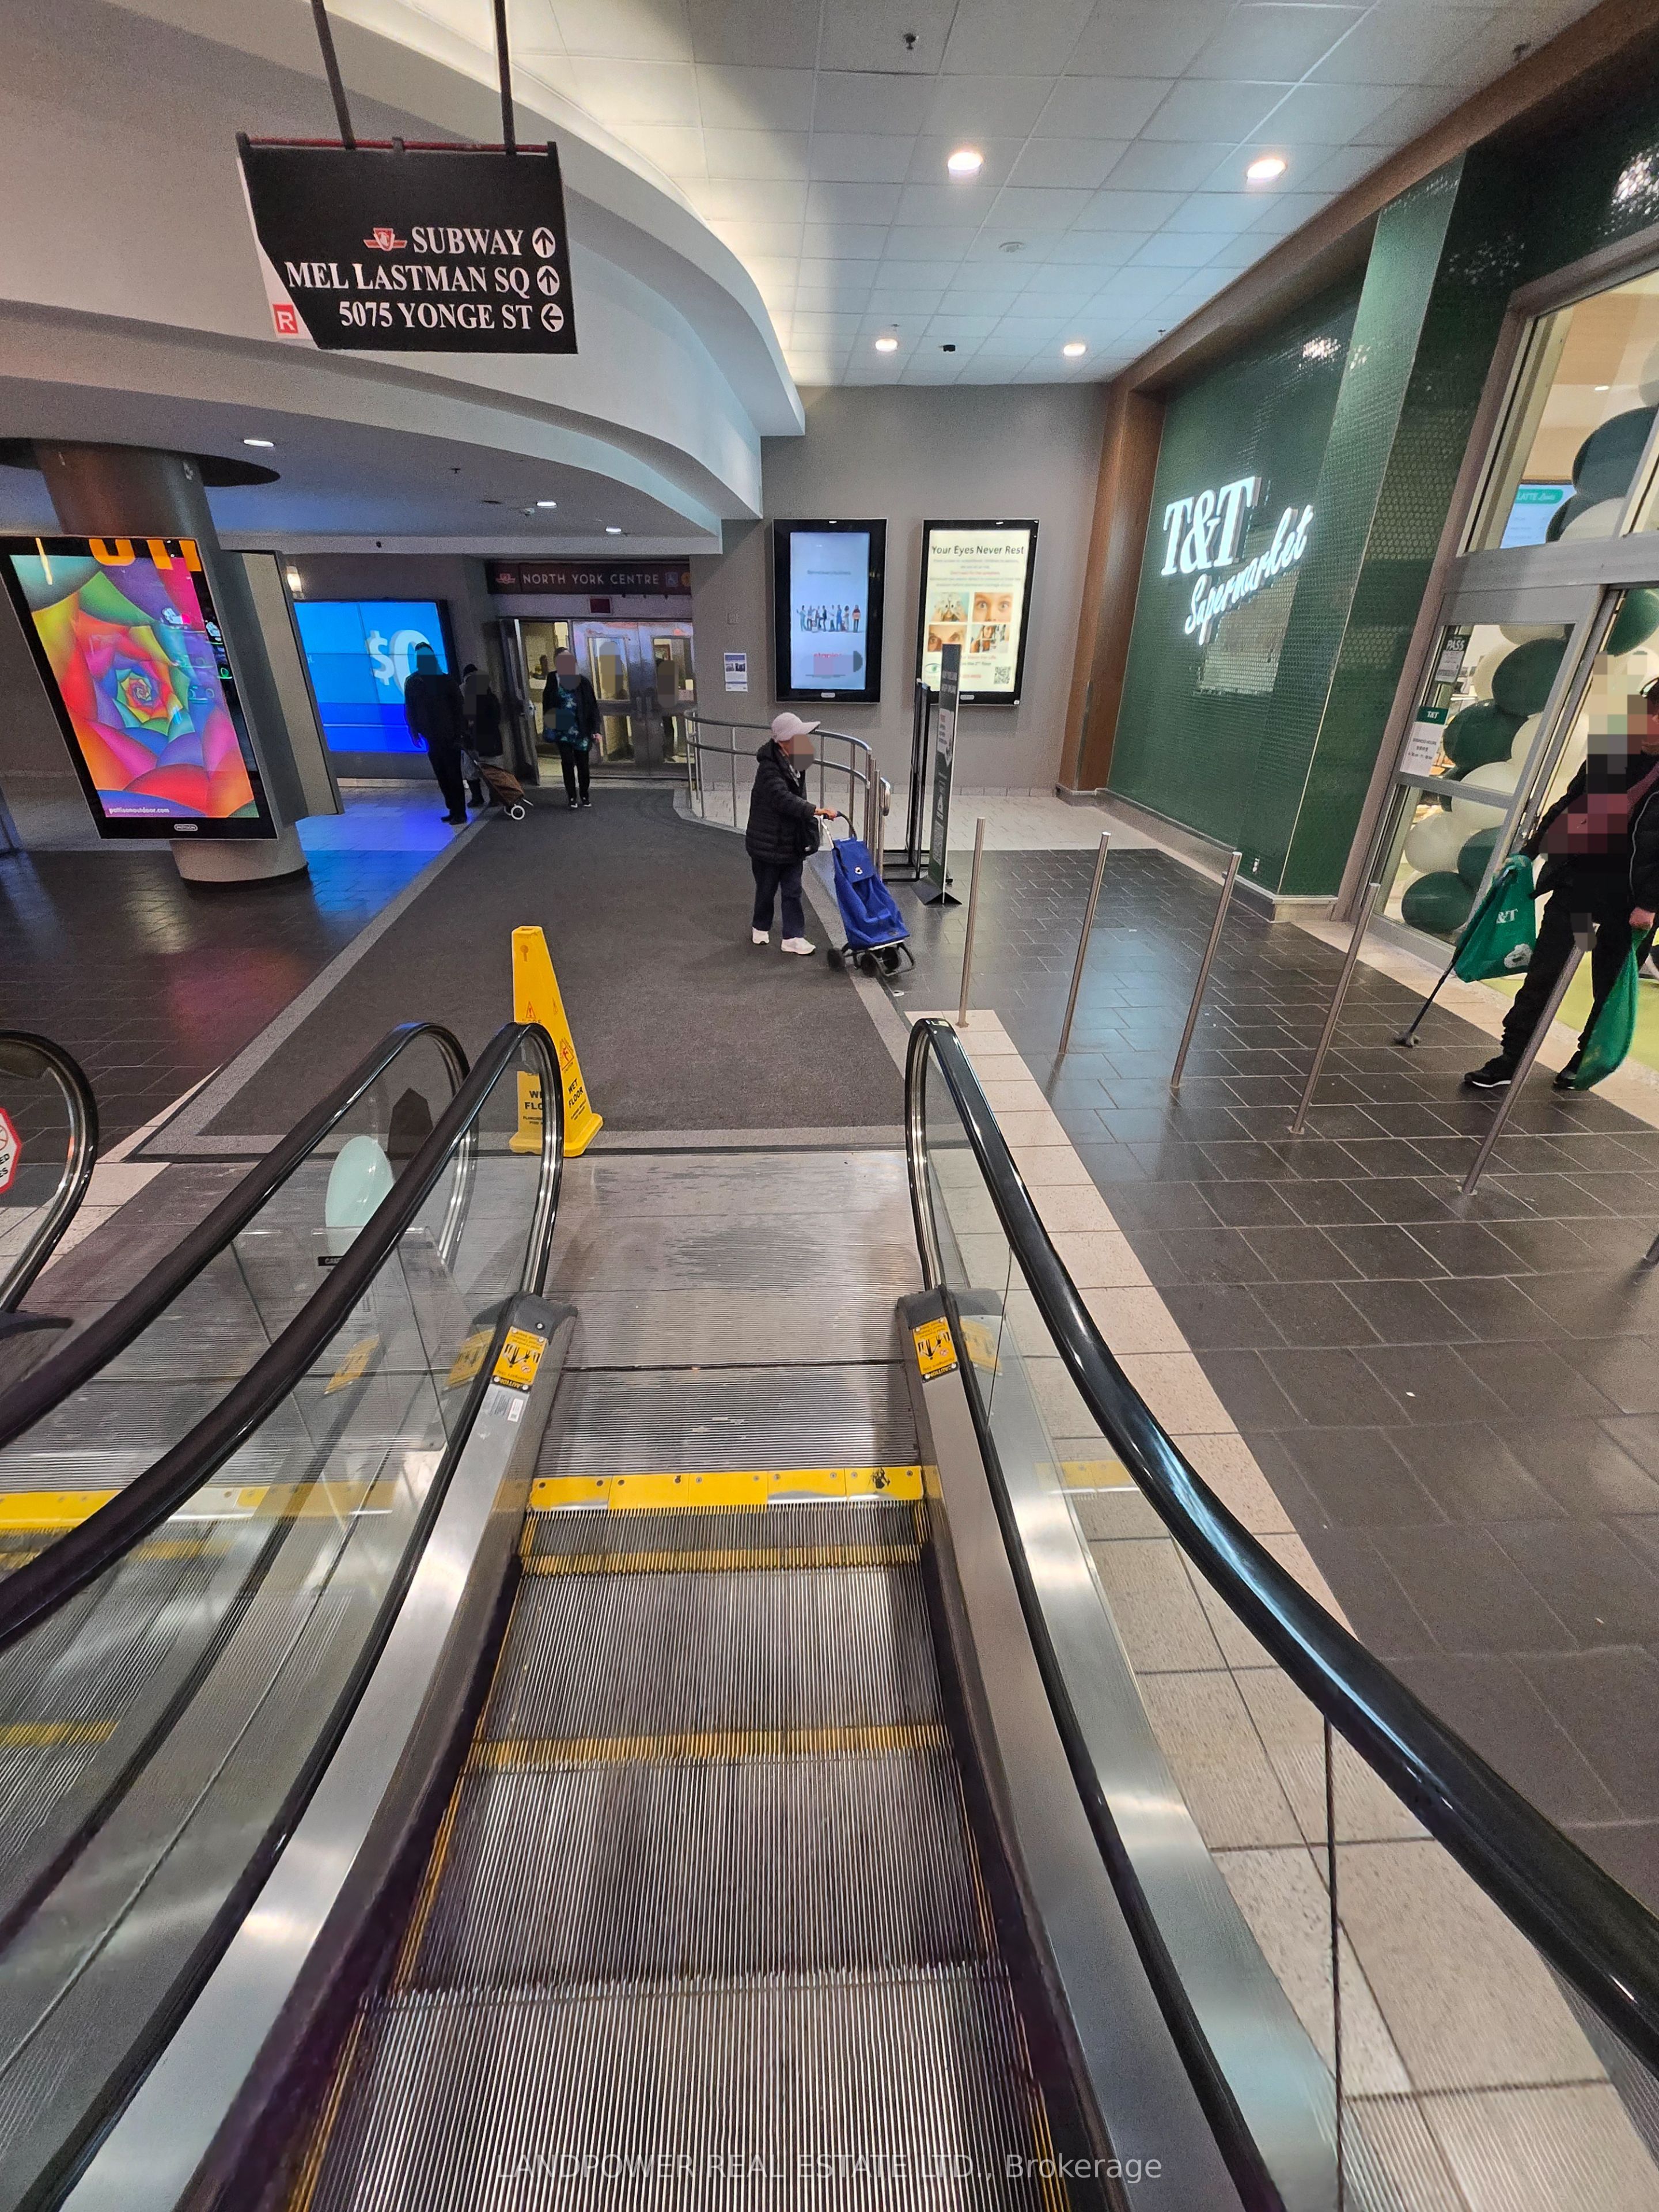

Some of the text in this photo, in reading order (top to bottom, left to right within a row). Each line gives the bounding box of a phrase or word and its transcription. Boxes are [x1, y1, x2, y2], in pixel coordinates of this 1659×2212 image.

[412, 226, 524, 255] SUBWAY
[285, 262, 530, 299] MEL LASTMAN SQ
[276, 311, 296, 331] R
[339, 302, 532, 329] 5075 YONGE ST
[1161, 476, 1257, 575] T&T
[931, 546, 1024, 557] Your Eyes Never Rest
[522, 573, 566, 585] NORTH
[571, 573, 604, 585] YORK
[610, 574, 660, 585] CENTRE
[1185, 505, 1315, 646] Supermarket
[1446, 639, 1465, 650] PASS
[1496, 908, 1518, 924] &T
[568, 1078, 578, 1094] WET
[525, 1102, 543, 1110] FLO
[569, 1086, 584, 1108] FLOOR
